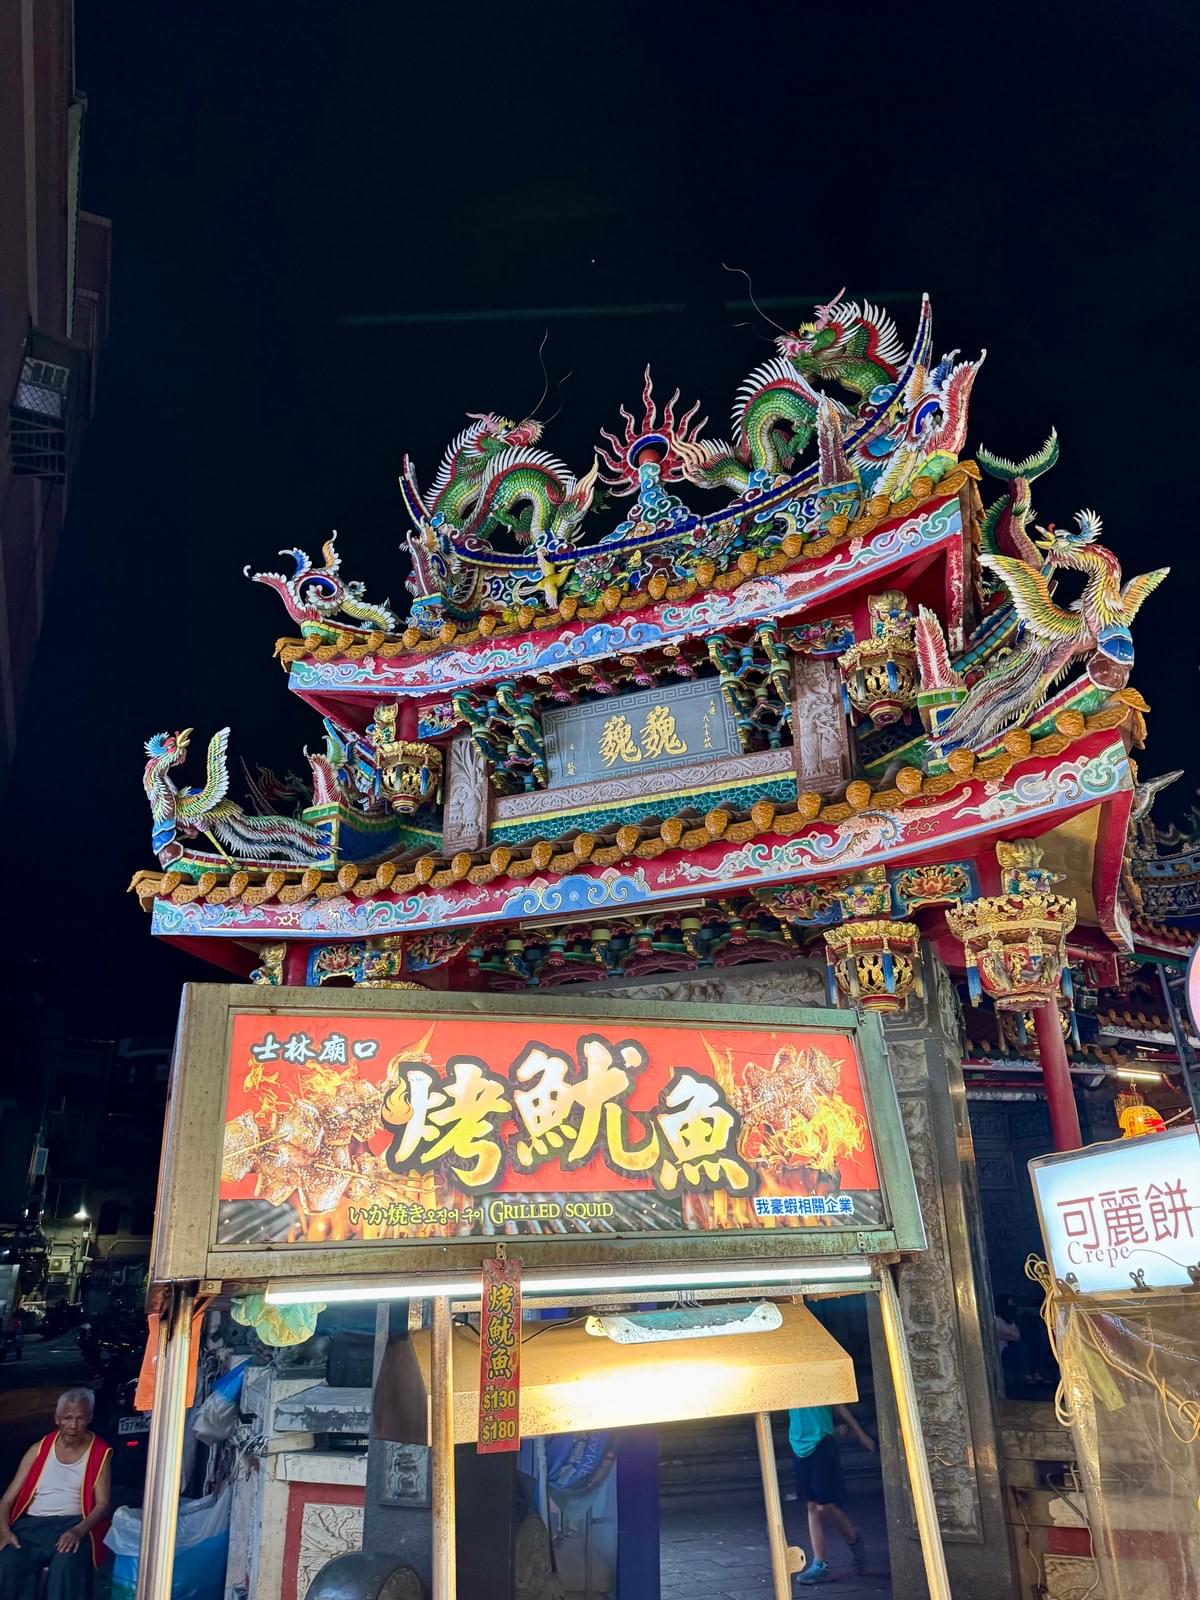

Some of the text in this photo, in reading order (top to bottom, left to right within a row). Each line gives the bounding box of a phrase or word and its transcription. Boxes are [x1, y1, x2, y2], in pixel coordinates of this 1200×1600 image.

[252, 1033, 378, 1063] 士林廟口
[384, 1040, 750, 1191] 烤魷魚
[349, 1203, 425, 1226] いか焼き
[462, 1208, 485, 1225] 구이
[490, 1201, 615, 1224] GRILLED SQUID
[755, 1196, 854, 1216] 我豪蝦相關企業
[1057, 1178, 1194, 1250] 可麗餅
[1067, 1241, 1131, 1268] Crepe
[487, 1284, 515, 1381] 烤魷魚
[482, 1389, 517, 1412] $130
[480, 1419, 516, 1445] $180
